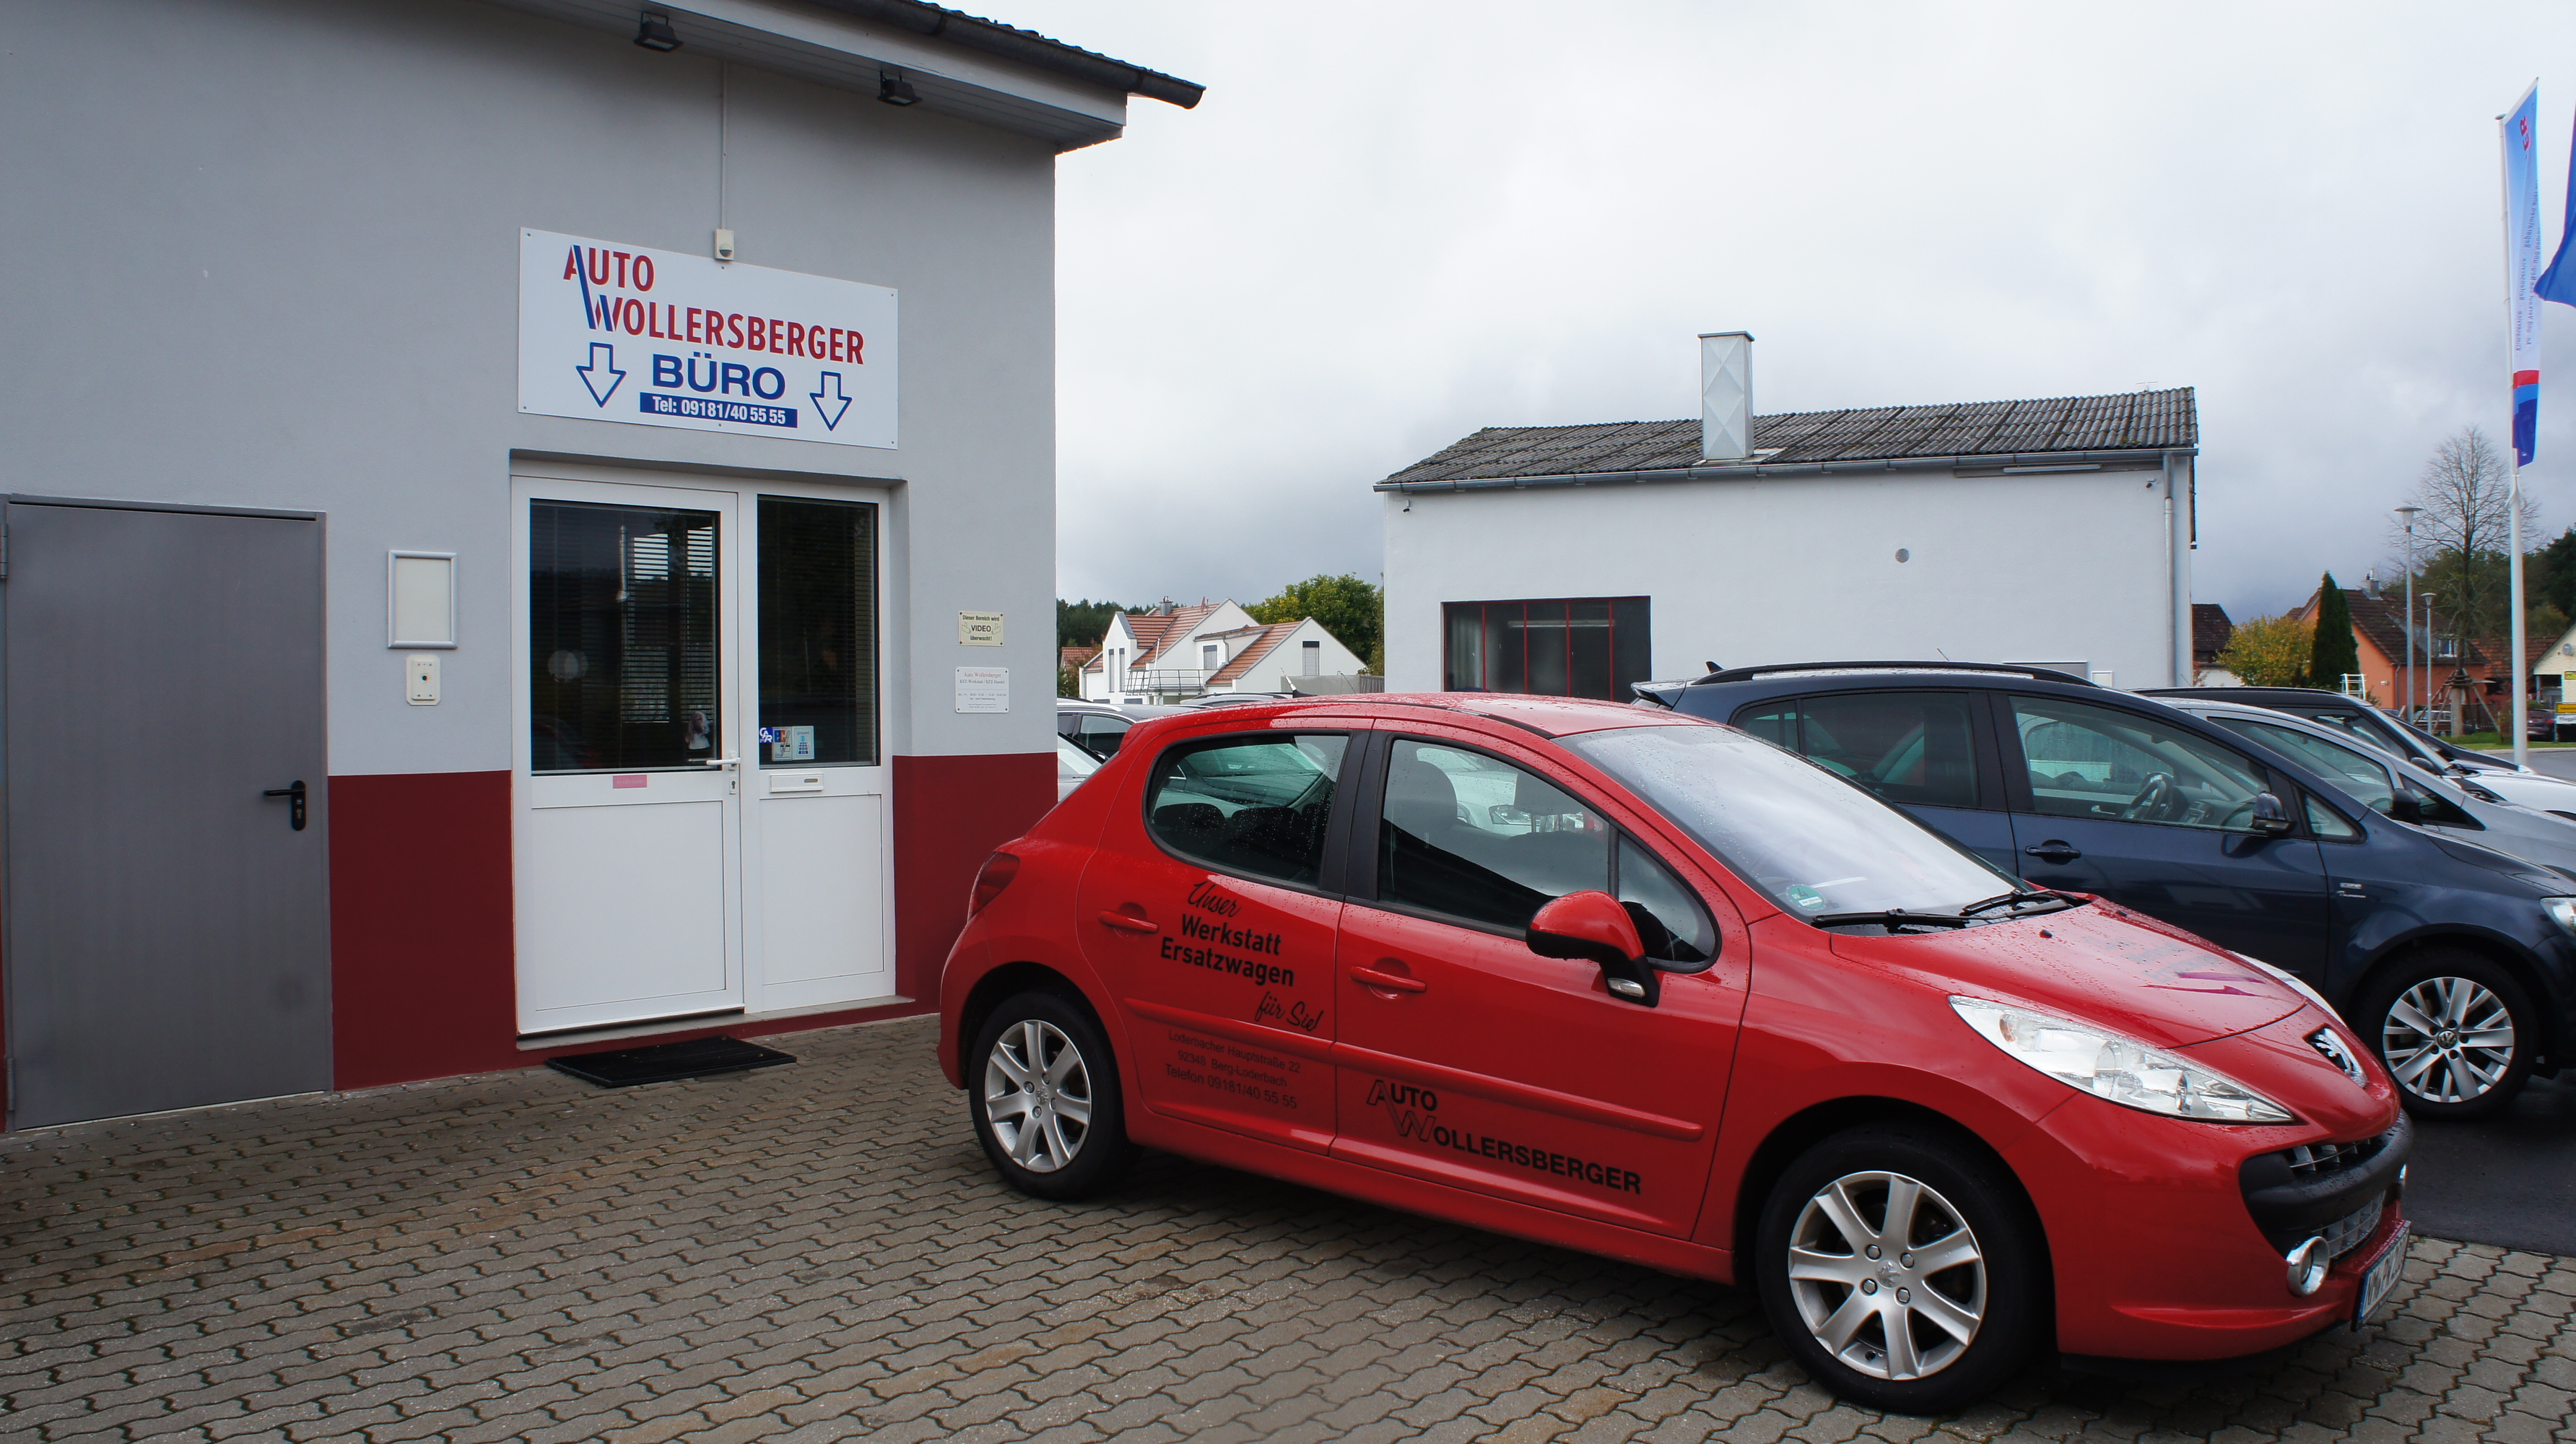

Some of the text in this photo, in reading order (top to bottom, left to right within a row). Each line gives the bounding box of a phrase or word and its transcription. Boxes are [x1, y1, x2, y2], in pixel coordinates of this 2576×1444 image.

[563, 245, 654, 292] AUTO
[583, 293, 865, 365] WOLLERSBERGER
[652, 352, 786, 400] BÜRO
[653, 396, 786, 425] Tel: 09181/40 55 55
[1187, 880, 1242, 918] Unser
[1181, 913, 1282, 955] Werkstatt
[1160, 936, 1295, 986] Ersatzwagen
[1255, 991, 1286, 1022] für
[1169, 1030, 1301, 1074] Loderbacher Hauptstraße 22
[1178, 1049, 1287, 1087] 92348 Berg-Loderbach
[1165, 1063, 1297, 1109] Telefon 09181/40 55 55
[1367, 1079, 1437, 1111] AUTO
[1398, 1110, 1641, 1195] WOLLERSBERGER
